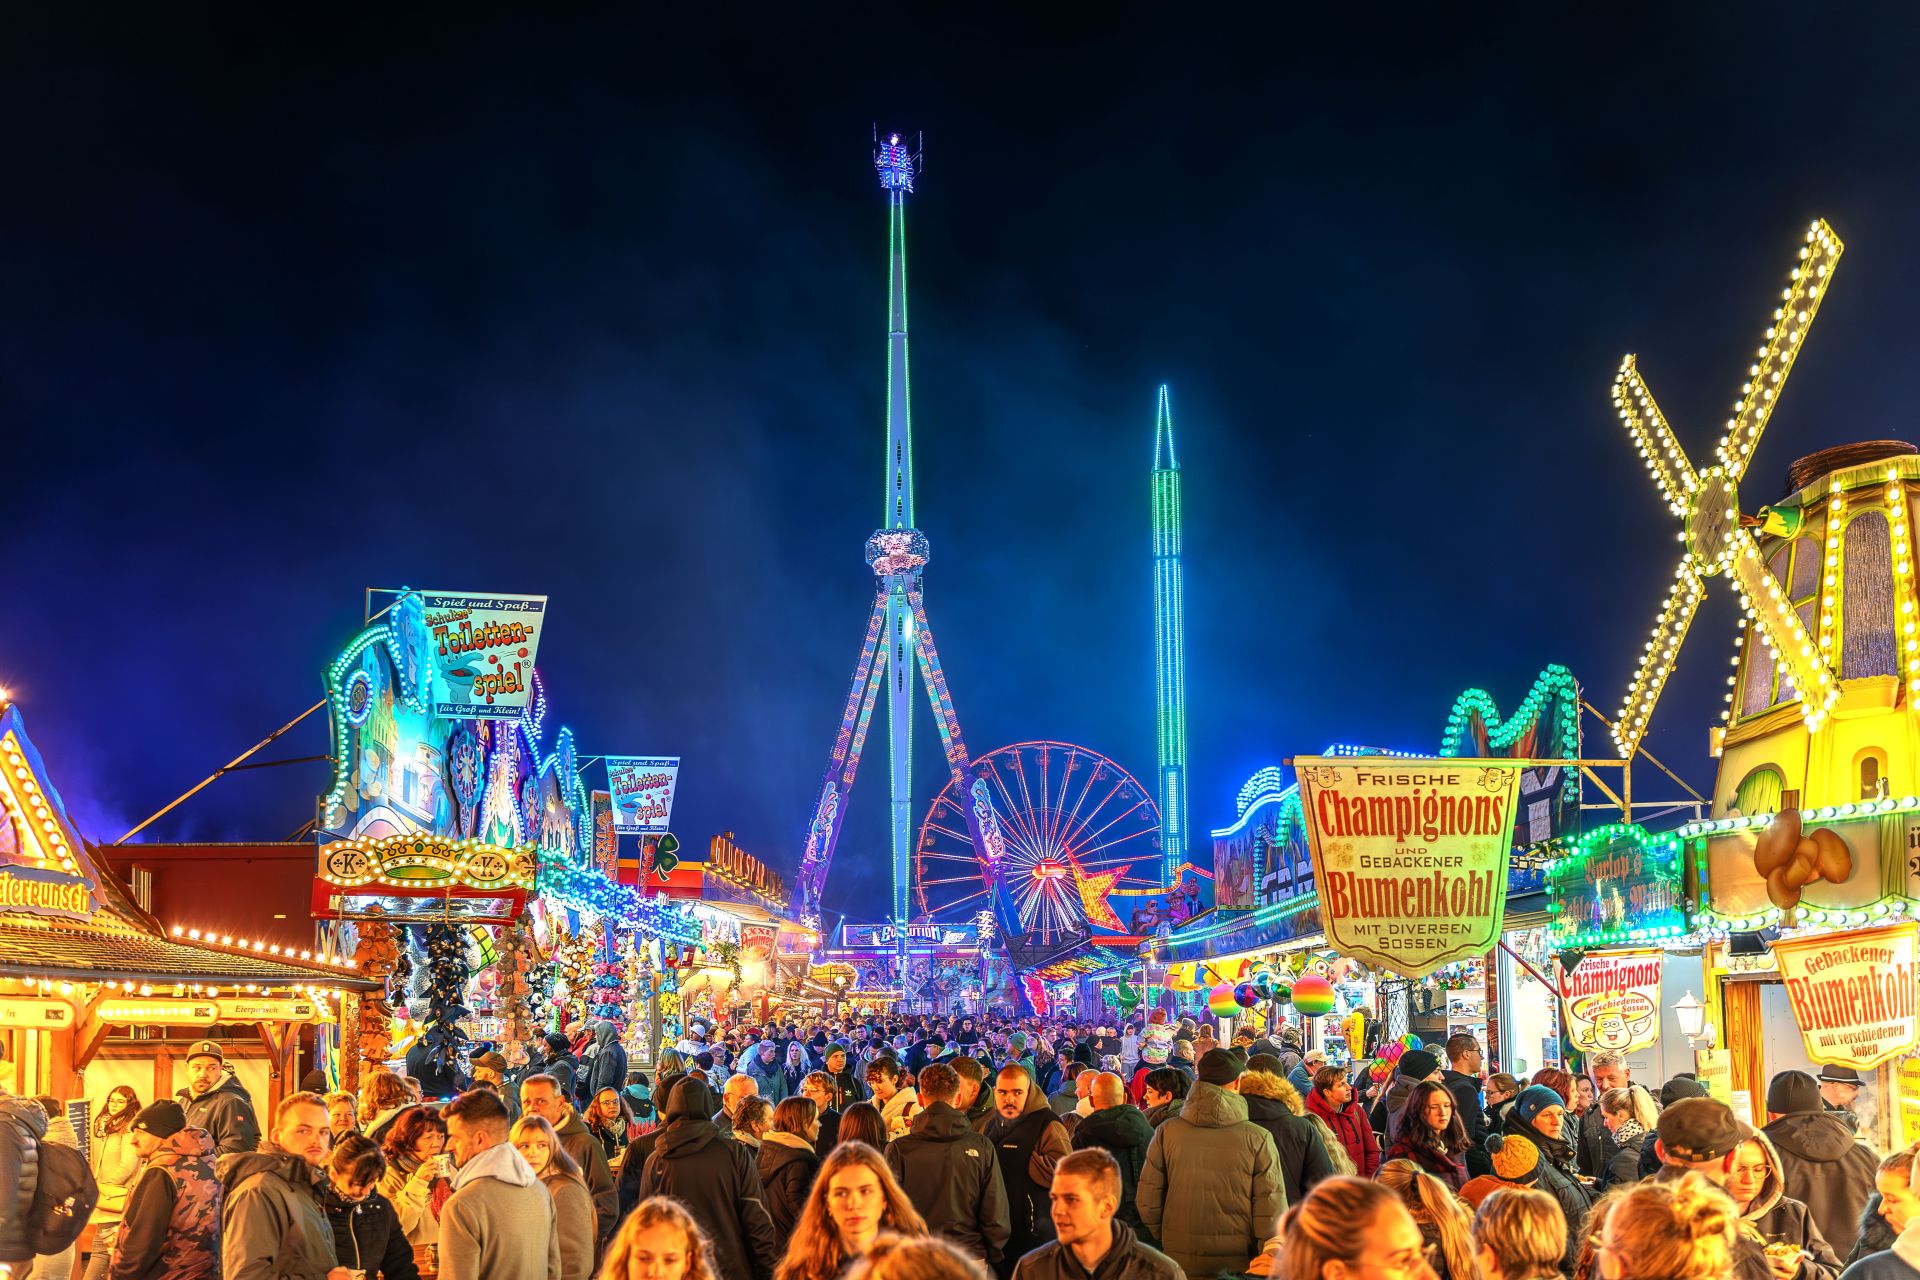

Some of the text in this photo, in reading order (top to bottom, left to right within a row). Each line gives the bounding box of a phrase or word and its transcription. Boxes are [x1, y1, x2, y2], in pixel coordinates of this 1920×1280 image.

[434, 598, 466, 608] Spiel
[469, 600, 493, 608] und
[433, 621, 534, 656] Toiletten-
[474, 662, 524, 704] spiel
[439, 705, 453, 714] für
[455, 705, 477, 714] Groß
[493, 706, 520, 715] Klein!
[612, 759, 632, 767] Spiel
[612, 773, 672, 795] Toiletten-
[1357, 773, 1460, 786] FRISCHE
[637, 798, 667, 824] spiel
[1318, 788, 1503, 843] Champignons
[1360, 855, 1463, 868] GEBACKENER
[1395, 847, 1427, 855] UND
[343, 854, 357, 875] K
[481, 857, 495, 878] K
[0, 870, 90, 914] ierpunsch
[1326, 870, 1493, 919] Blumenkohl
[881, 926, 941, 942] EVUTION
[1354, 923, 1472, 936] MIT DIVERSEN
[741, 933, 776, 948] Pommes
[1379, 937, 1447, 949] SOSSEN
[1805, 946, 1894, 975] Gebackener
[1560, 960, 1660, 999] Champignons
[1587, 999, 1599, 1009] mit
[1788, 962, 1915, 1032] Blumenkohl
[1582, 998, 1645, 1019] verschiedenen
[1621, 1005, 1649, 1013] Sossen
[1820, 1025, 1905, 1047] mit verschiedenen
[1851, 1043, 1878, 1057] Soßen
